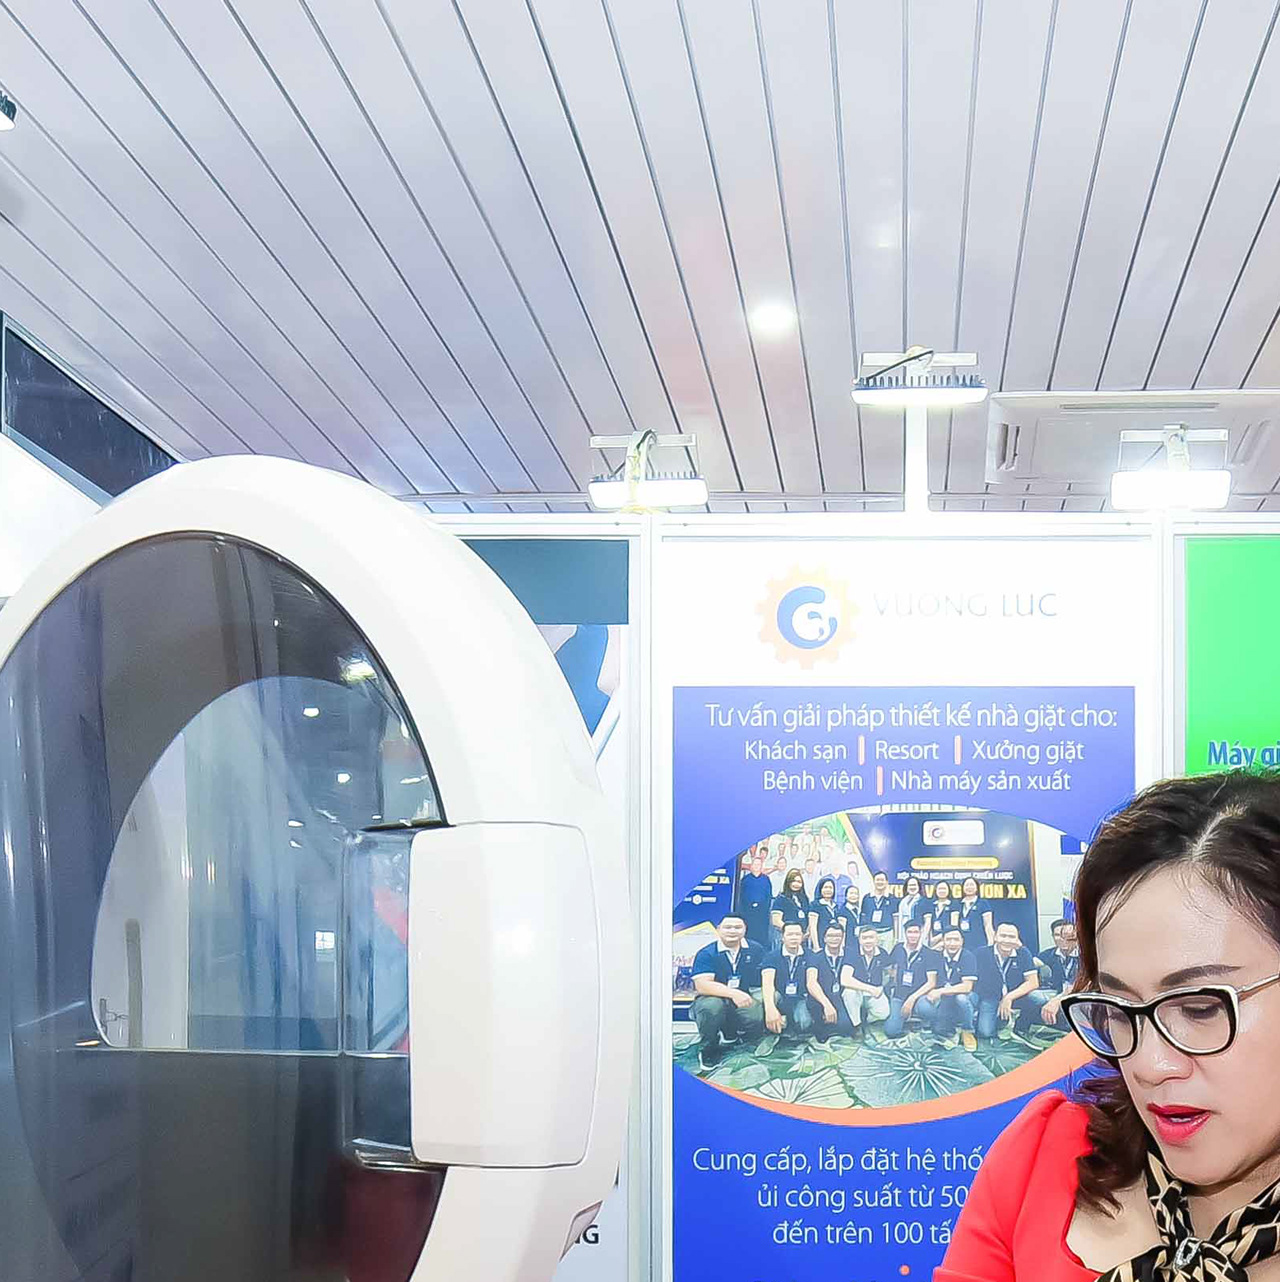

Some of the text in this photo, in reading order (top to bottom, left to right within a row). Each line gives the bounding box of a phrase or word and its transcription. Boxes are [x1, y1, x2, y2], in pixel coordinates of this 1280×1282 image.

[1003, 592, 1059, 617] LUC
[705, 696, 1119, 735] Tư vấn giải pháp thiết kế nhà giặt cho:
[744, 737, 1086, 767] Khách sạn Resort Xưởng giặt
[1207, 739, 1256, 768] Máy
[763, 766, 1072, 798] Bệnh viện Nhà máy sản xuất
[692, 1143, 983, 1177] Cung cấp, lắp đặt hệ thố
[757, 1184, 779, 1208] ủi
[785, 1184, 847, 1214] công
[853, 1182, 903, 1209] suất
[908, 1184, 935, 1209] từ
[773, 1217, 952, 1246] đến trên 100 tấ
